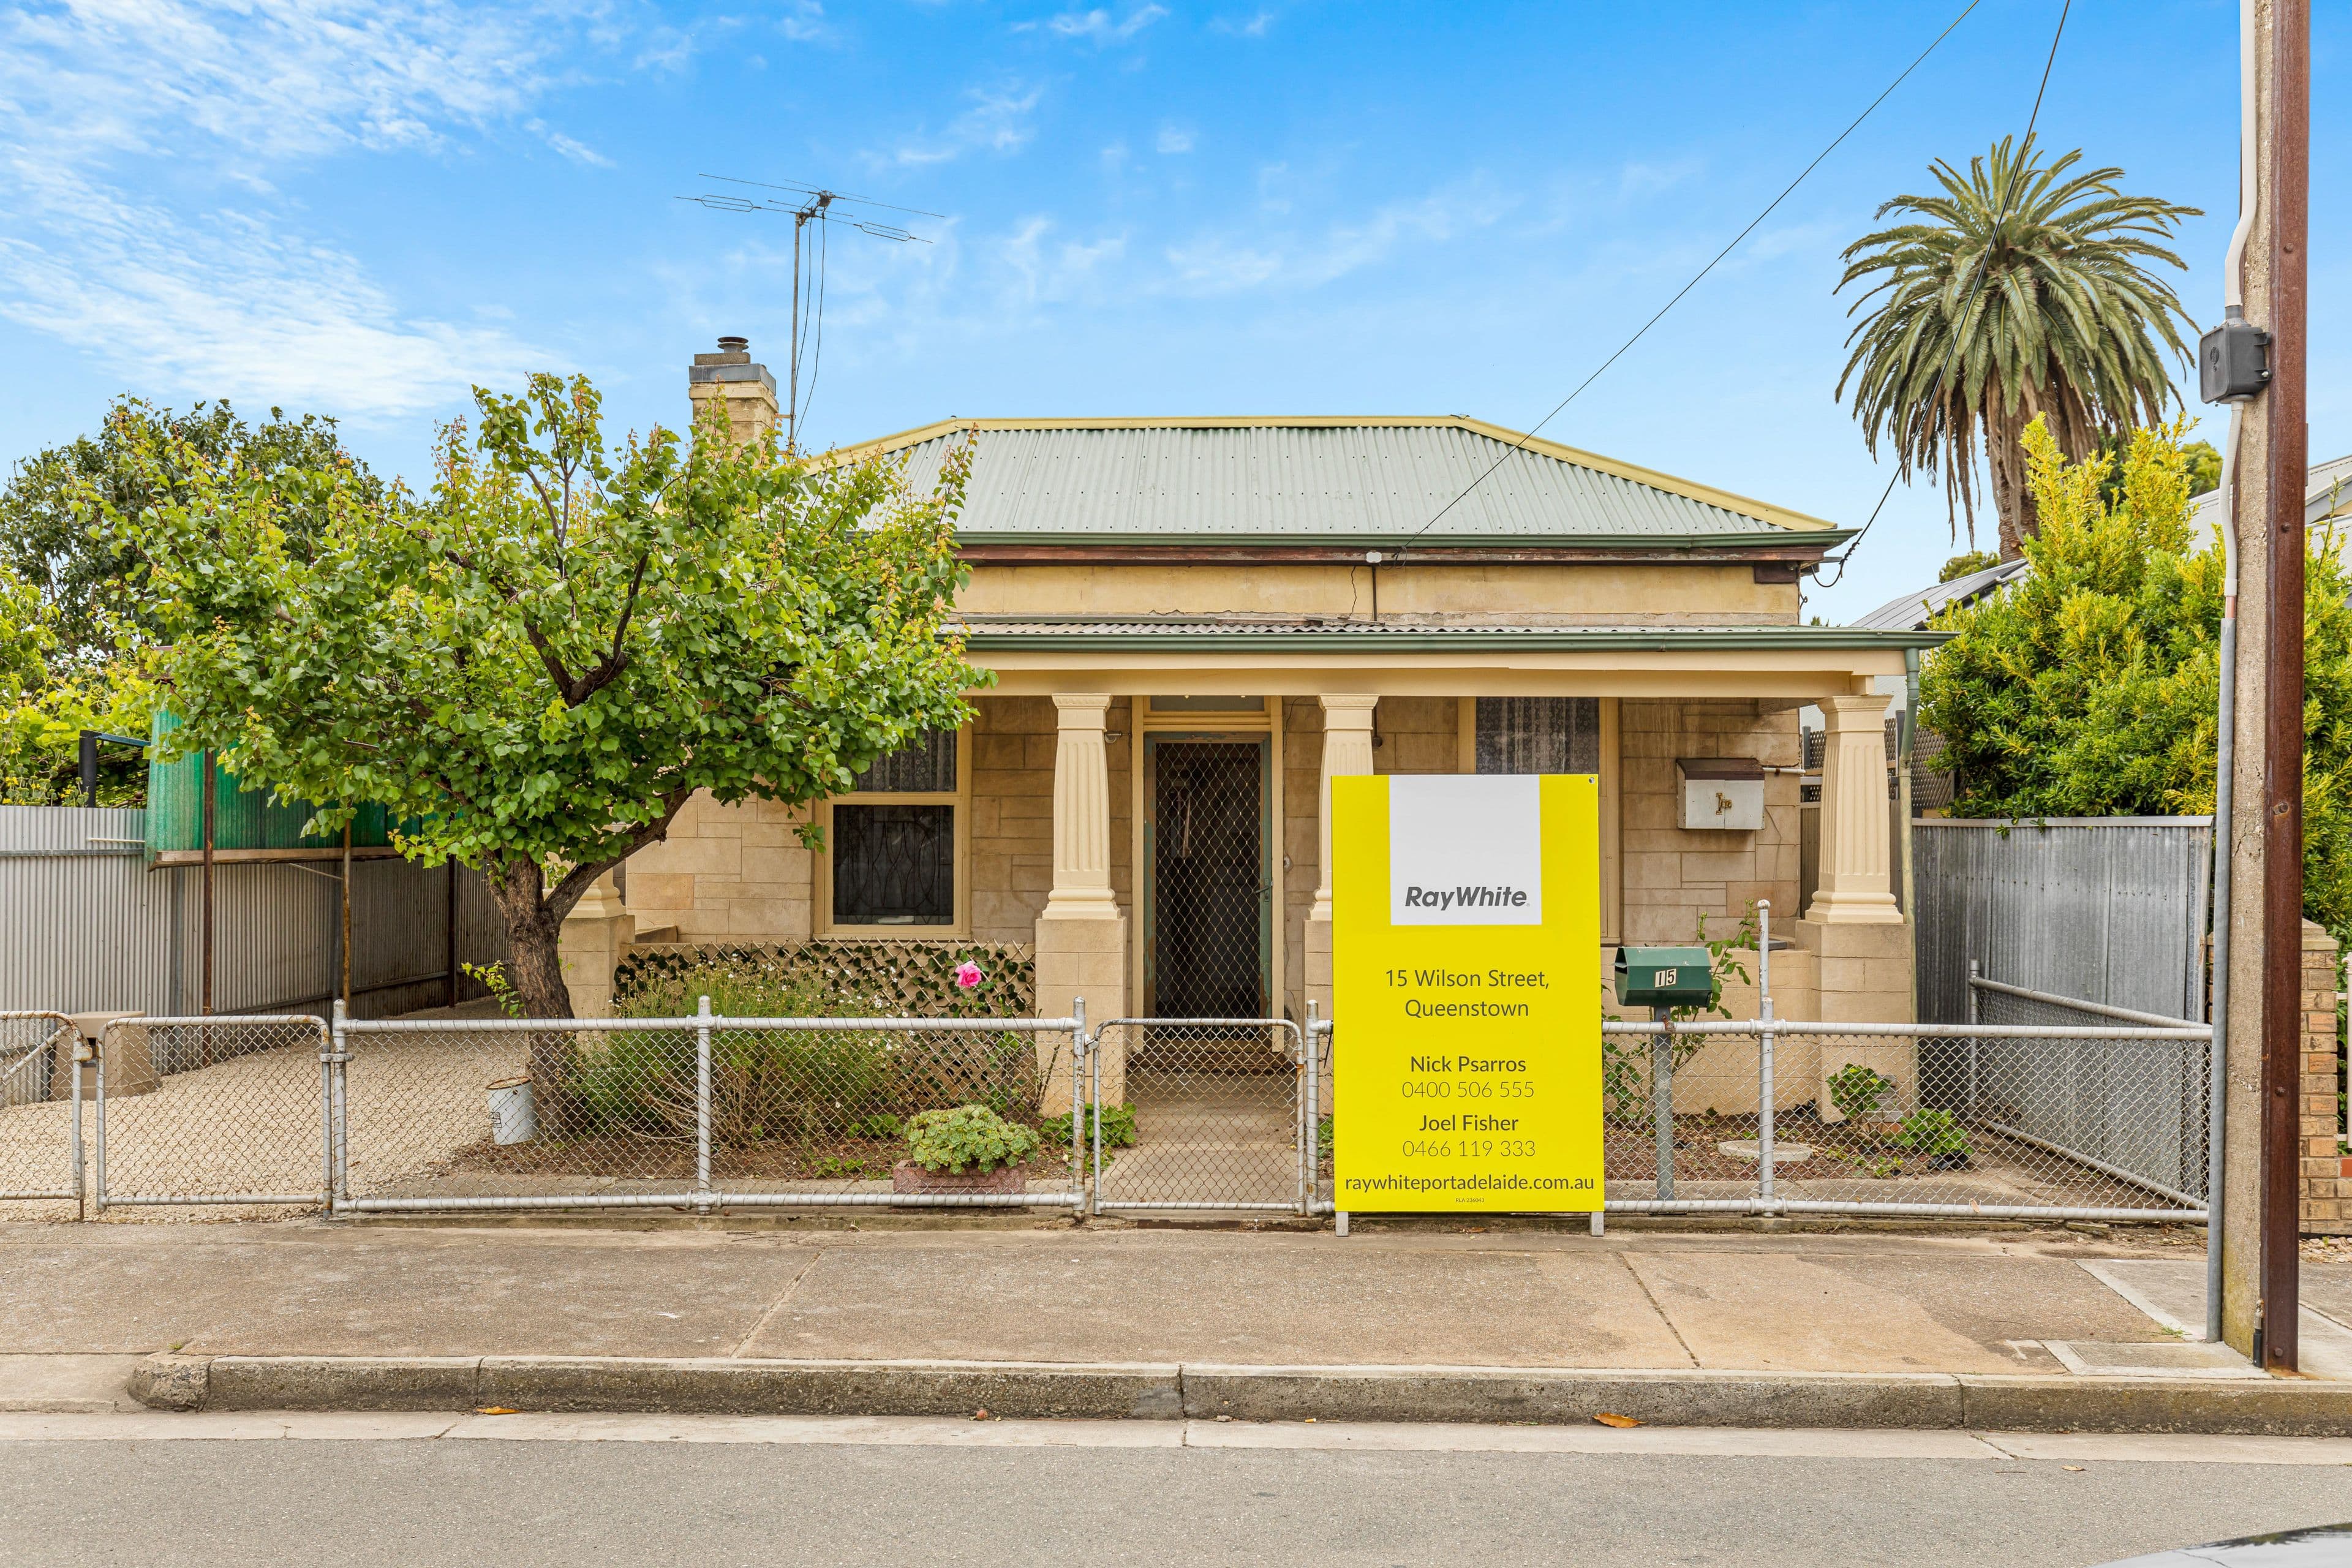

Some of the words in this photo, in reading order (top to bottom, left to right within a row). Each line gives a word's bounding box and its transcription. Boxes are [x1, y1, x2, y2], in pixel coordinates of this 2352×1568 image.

[1385, 969, 1408, 987] 15
[1414, 969, 1481, 987] Wilson
[1488, 969, 1549, 990] Street,
[1658, 969, 1675, 986] 15
[1404, 998, 1529, 1019] Queenstown
[1411, 1055, 1452, 1072] Nick
[1458, 1055, 1526, 1072] Psarros
[1402, 1081, 1450, 1098] 0400
[1457, 1081, 1493, 1098] 506
[1499, 1081, 1534, 1098] 555
[1419, 1114, 1456, 1132] Joel
[1463, 1114, 1519, 1131] Fisher
[1403, 1140, 1451, 1157] 0466
[1458, 1140, 1493, 1157] 119
[1500, 1140, 1536, 1157] 333
[1346, 1174, 1594, 1193] raywhiteportadelaide.com.au
